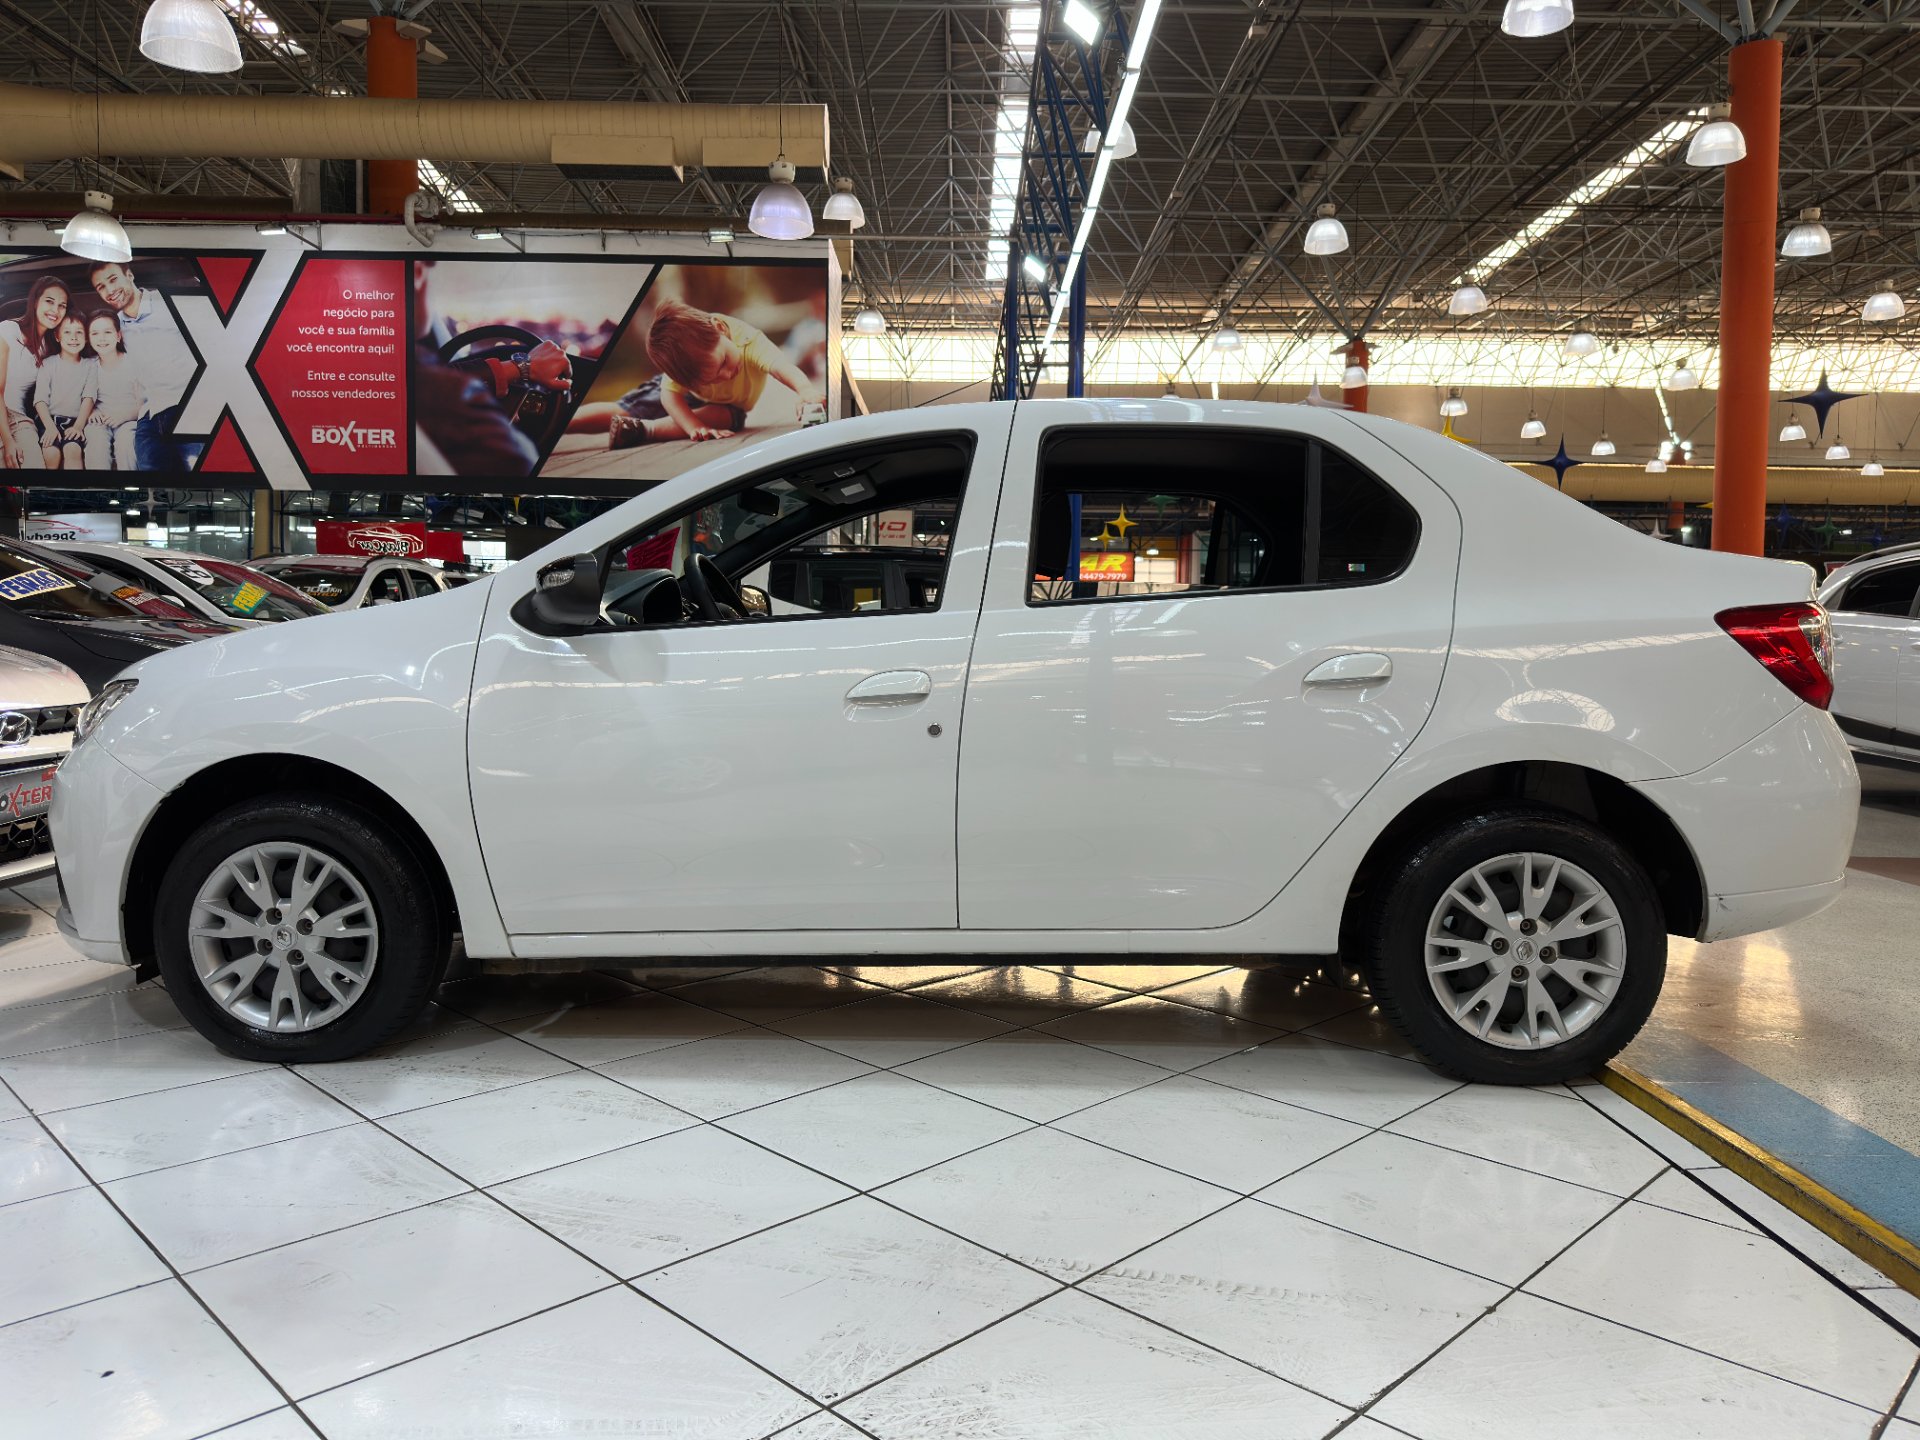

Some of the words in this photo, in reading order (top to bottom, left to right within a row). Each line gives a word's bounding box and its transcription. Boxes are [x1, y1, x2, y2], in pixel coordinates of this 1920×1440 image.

[342, 289, 353, 300] O
[355, 290, 395, 300] melhor
[323, 308, 368, 320] negócio
[370, 309, 395, 320] para
[298, 325, 325, 335] você
[327, 327, 335, 335] e
[337, 327, 356, 335] sua
[358, 326, 395, 336] família
[286, 343, 313, 353] você
[315, 344, 365, 353] encontra
[367, 344, 395, 355] aqui!
[307, 370, 336, 381] Entre
[339, 372, 346, 381] e
[348, 371, 396, 382] consulte
[291, 390, 330, 398] nossos
[332, 389, 396, 399] vendedores
[311, 421, 396, 452] BOXTER
